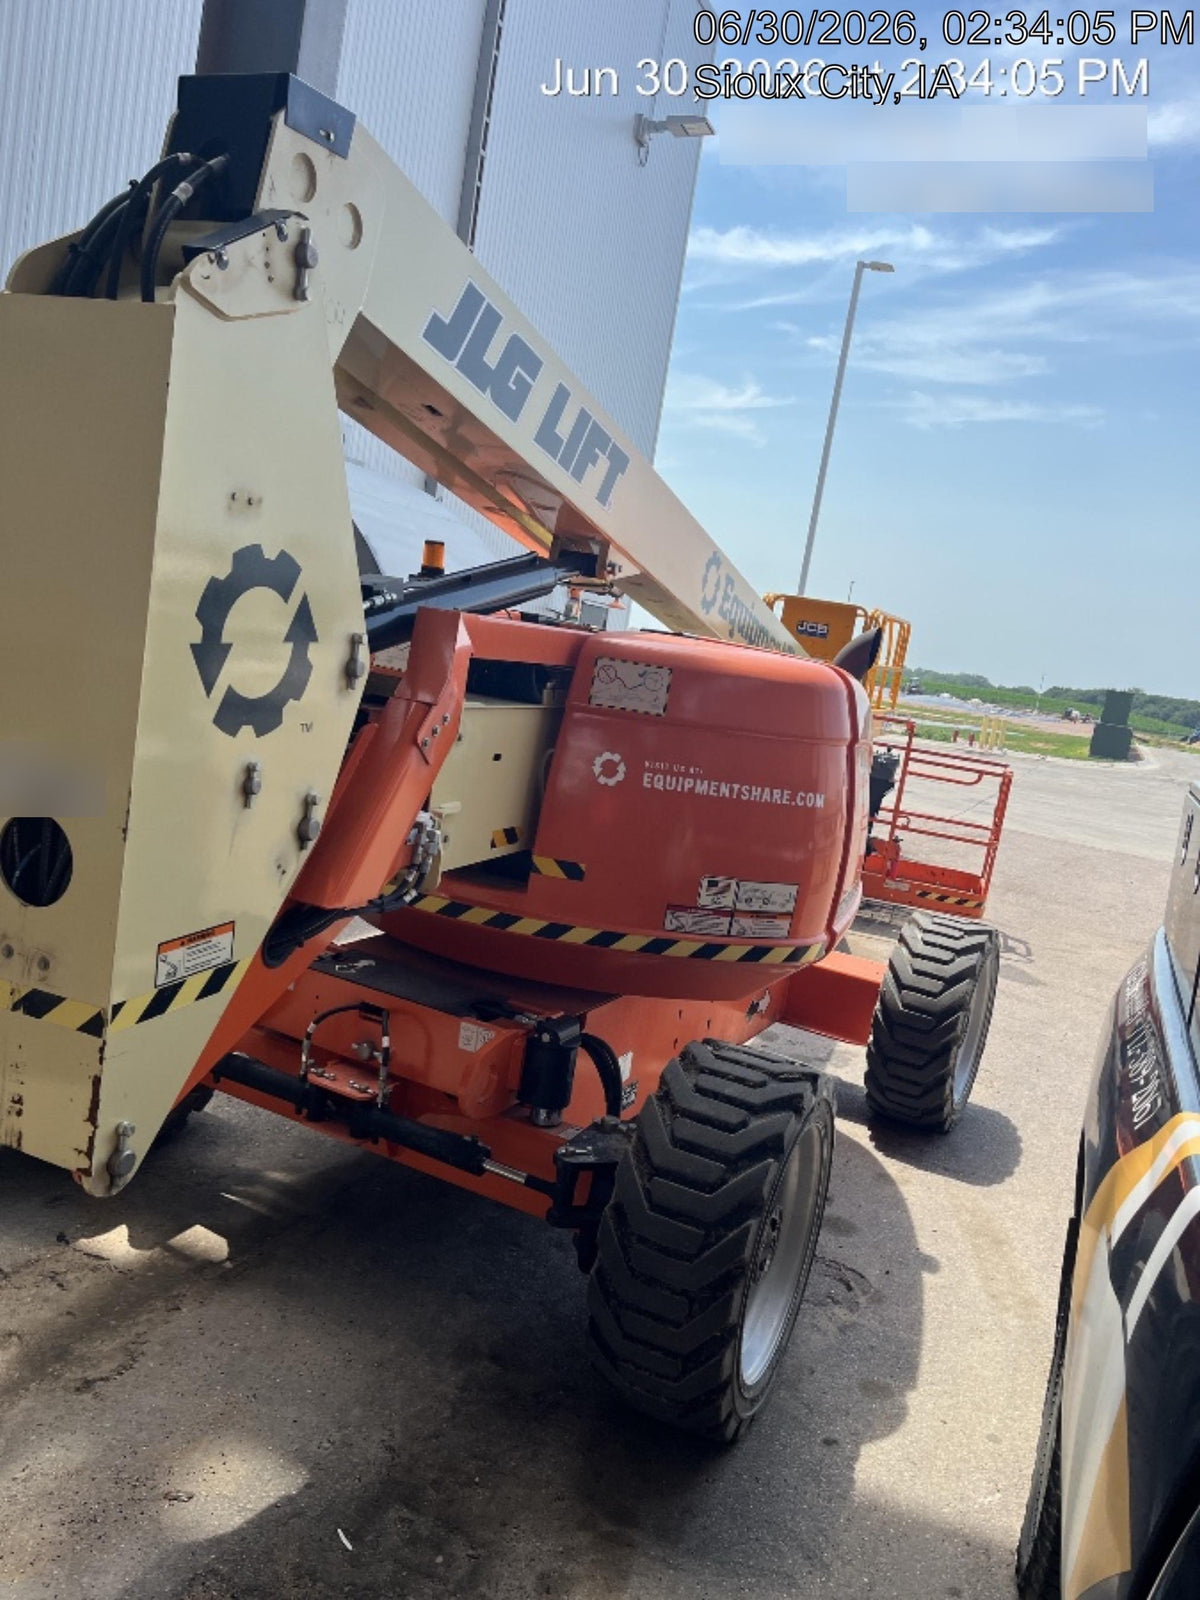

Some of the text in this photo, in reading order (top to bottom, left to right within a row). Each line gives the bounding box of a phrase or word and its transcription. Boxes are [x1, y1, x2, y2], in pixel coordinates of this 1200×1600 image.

[421, 278, 632, 508] JLG LIFT
[798, 621, 828, 635] JCB
[642, 771, 826, 809] EQUIPMENTSHARE.COM
